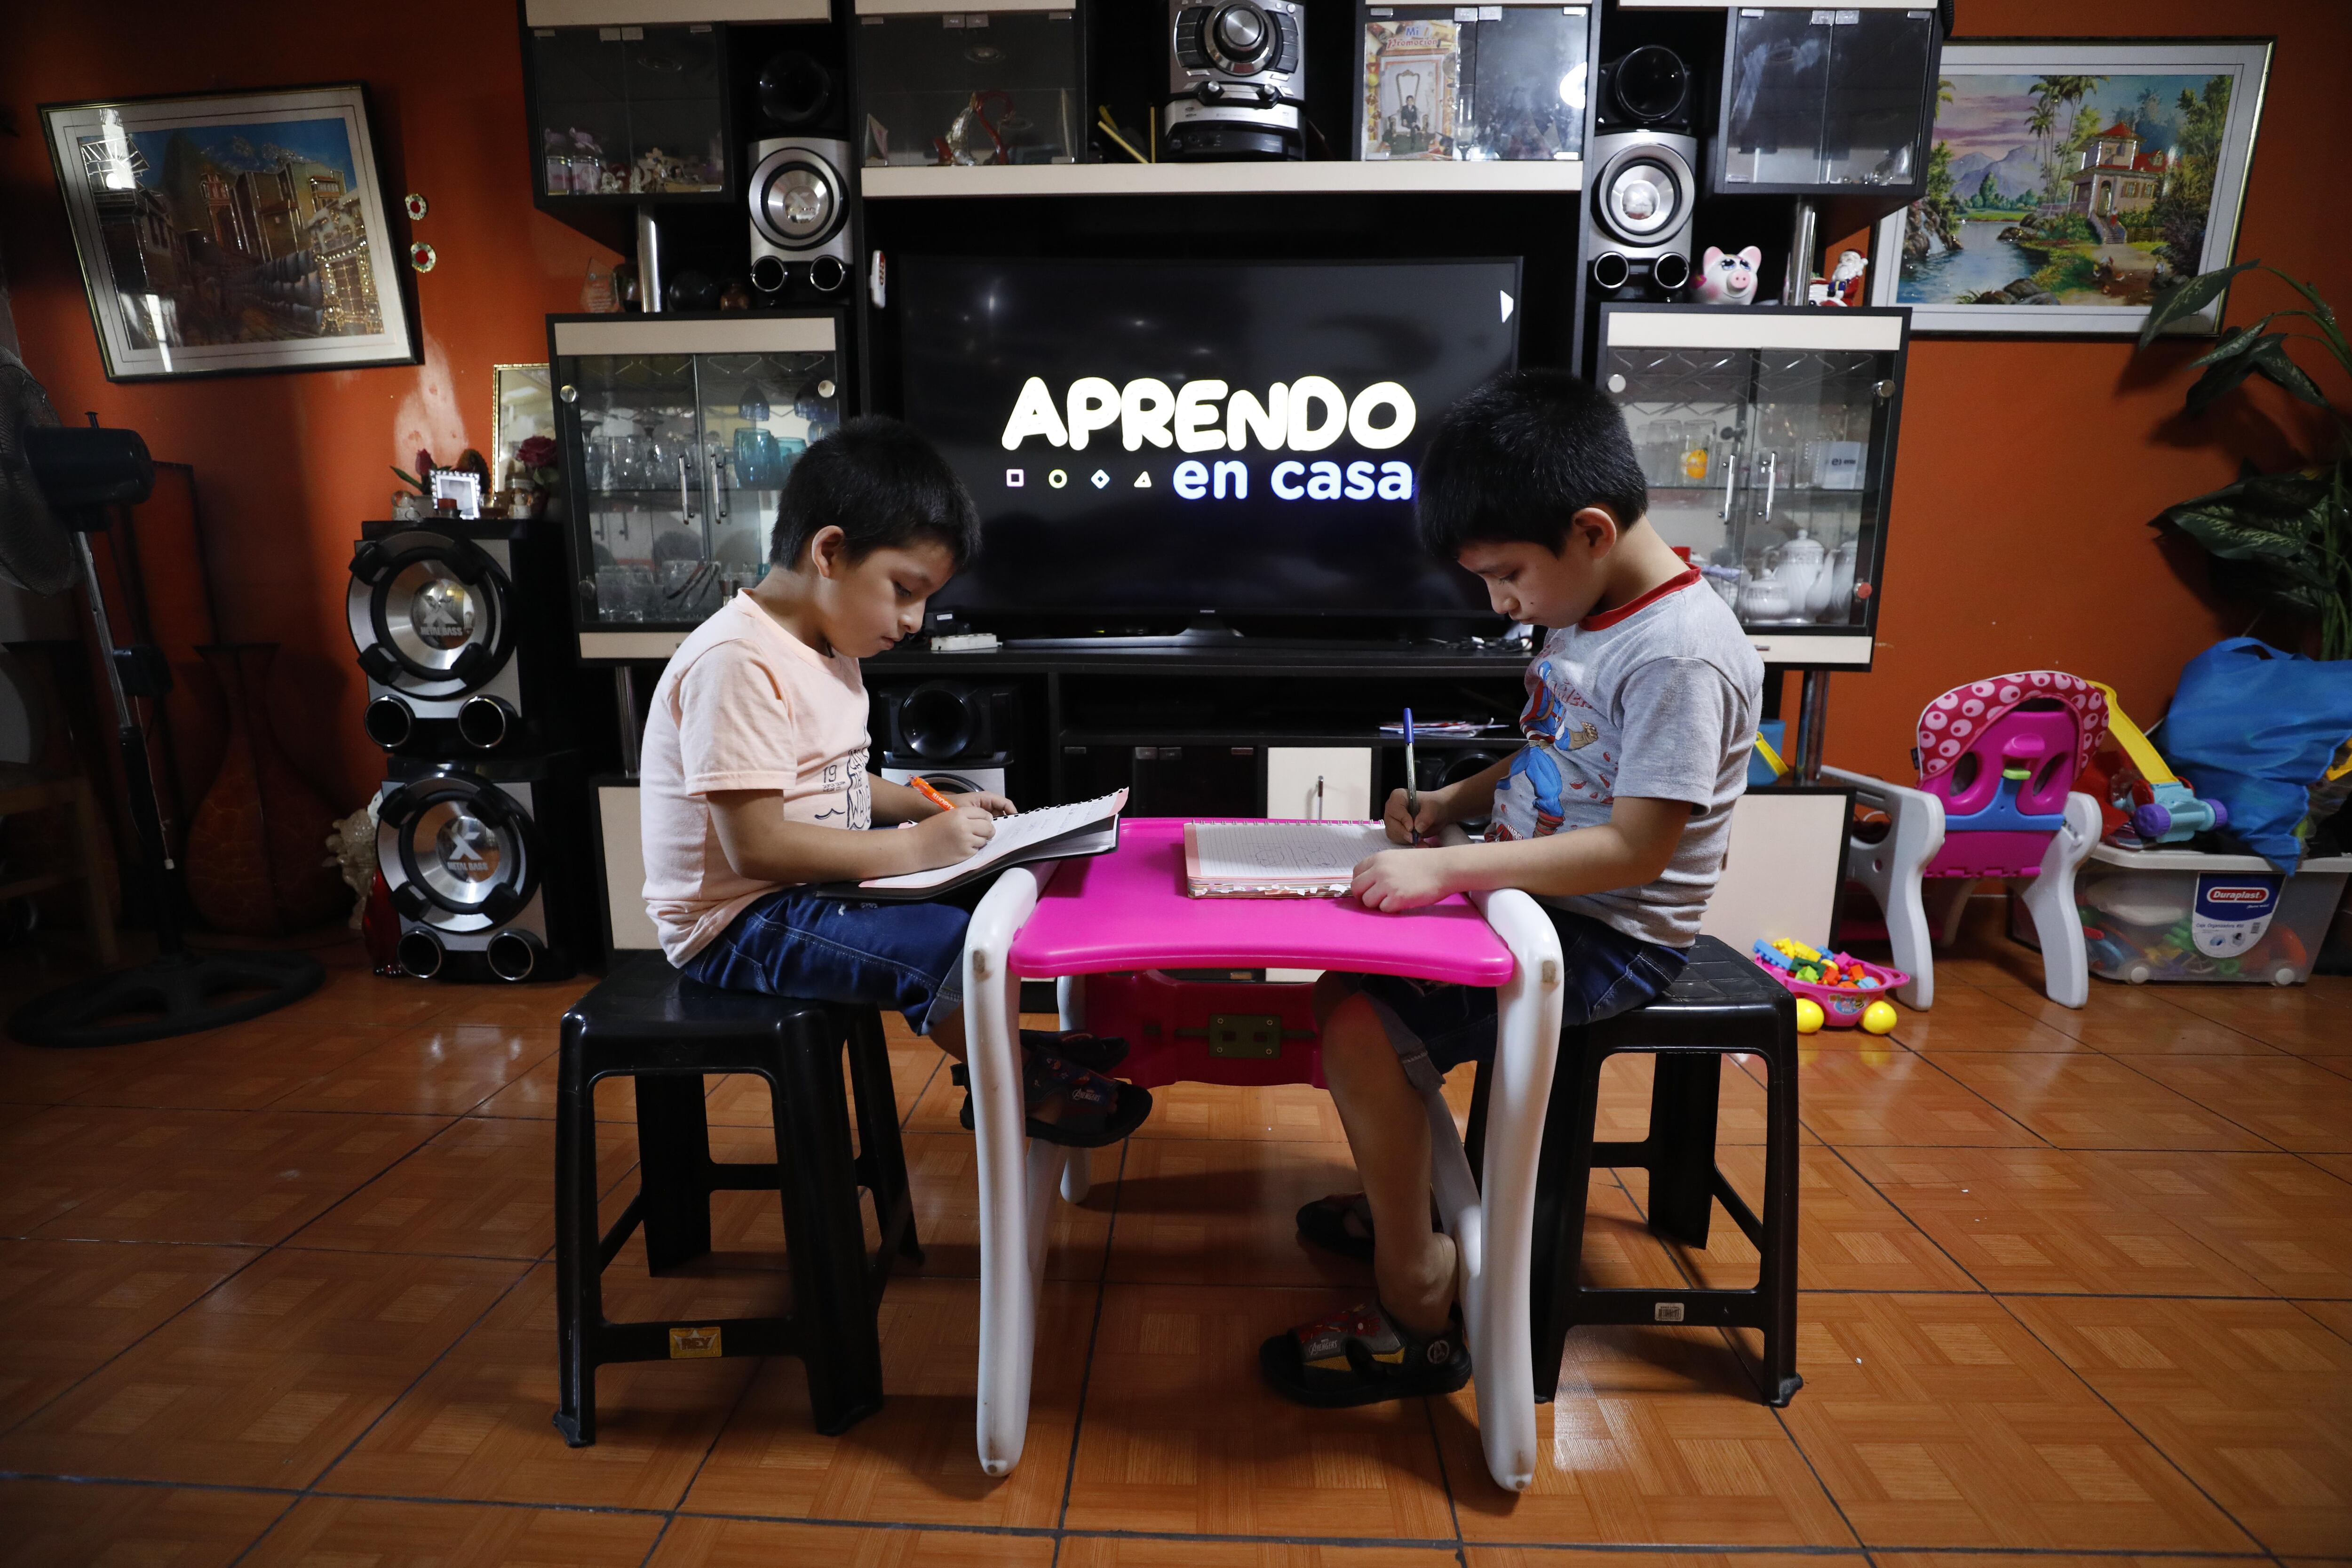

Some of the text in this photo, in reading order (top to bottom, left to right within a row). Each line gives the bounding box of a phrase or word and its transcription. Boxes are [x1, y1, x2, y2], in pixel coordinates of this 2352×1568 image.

[1406, 26, 1419, 36] Mi
[1001, 376, 1416, 453] APRENDO
[1173, 461, 1413, 500] en casa
[823, 765, 837, 783] 19
[2213, 891, 2260, 900] Duraplast
[1309, 1339, 1338, 1356] AVENGERS
